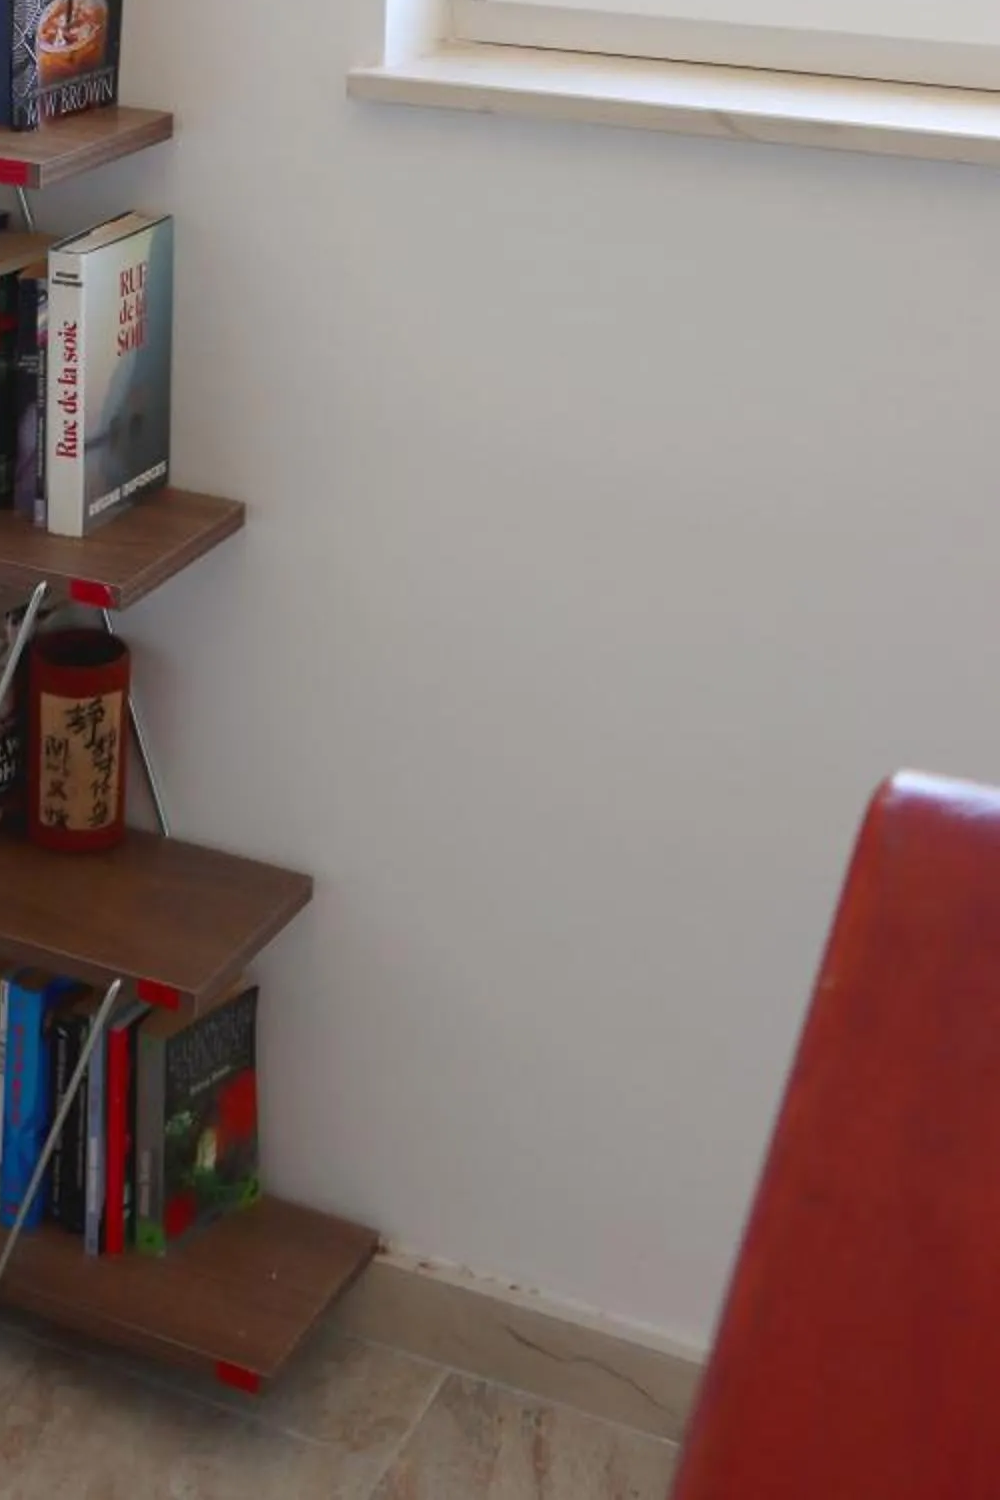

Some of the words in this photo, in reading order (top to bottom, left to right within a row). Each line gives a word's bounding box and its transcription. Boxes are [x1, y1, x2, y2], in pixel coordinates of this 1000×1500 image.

[60, 77, 114, 113] BROWN
[57, 321, 78, 363] soie
[57, 365, 78, 385] la
[57, 386, 78, 414] de
[56, 421, 78, 458] Rue
